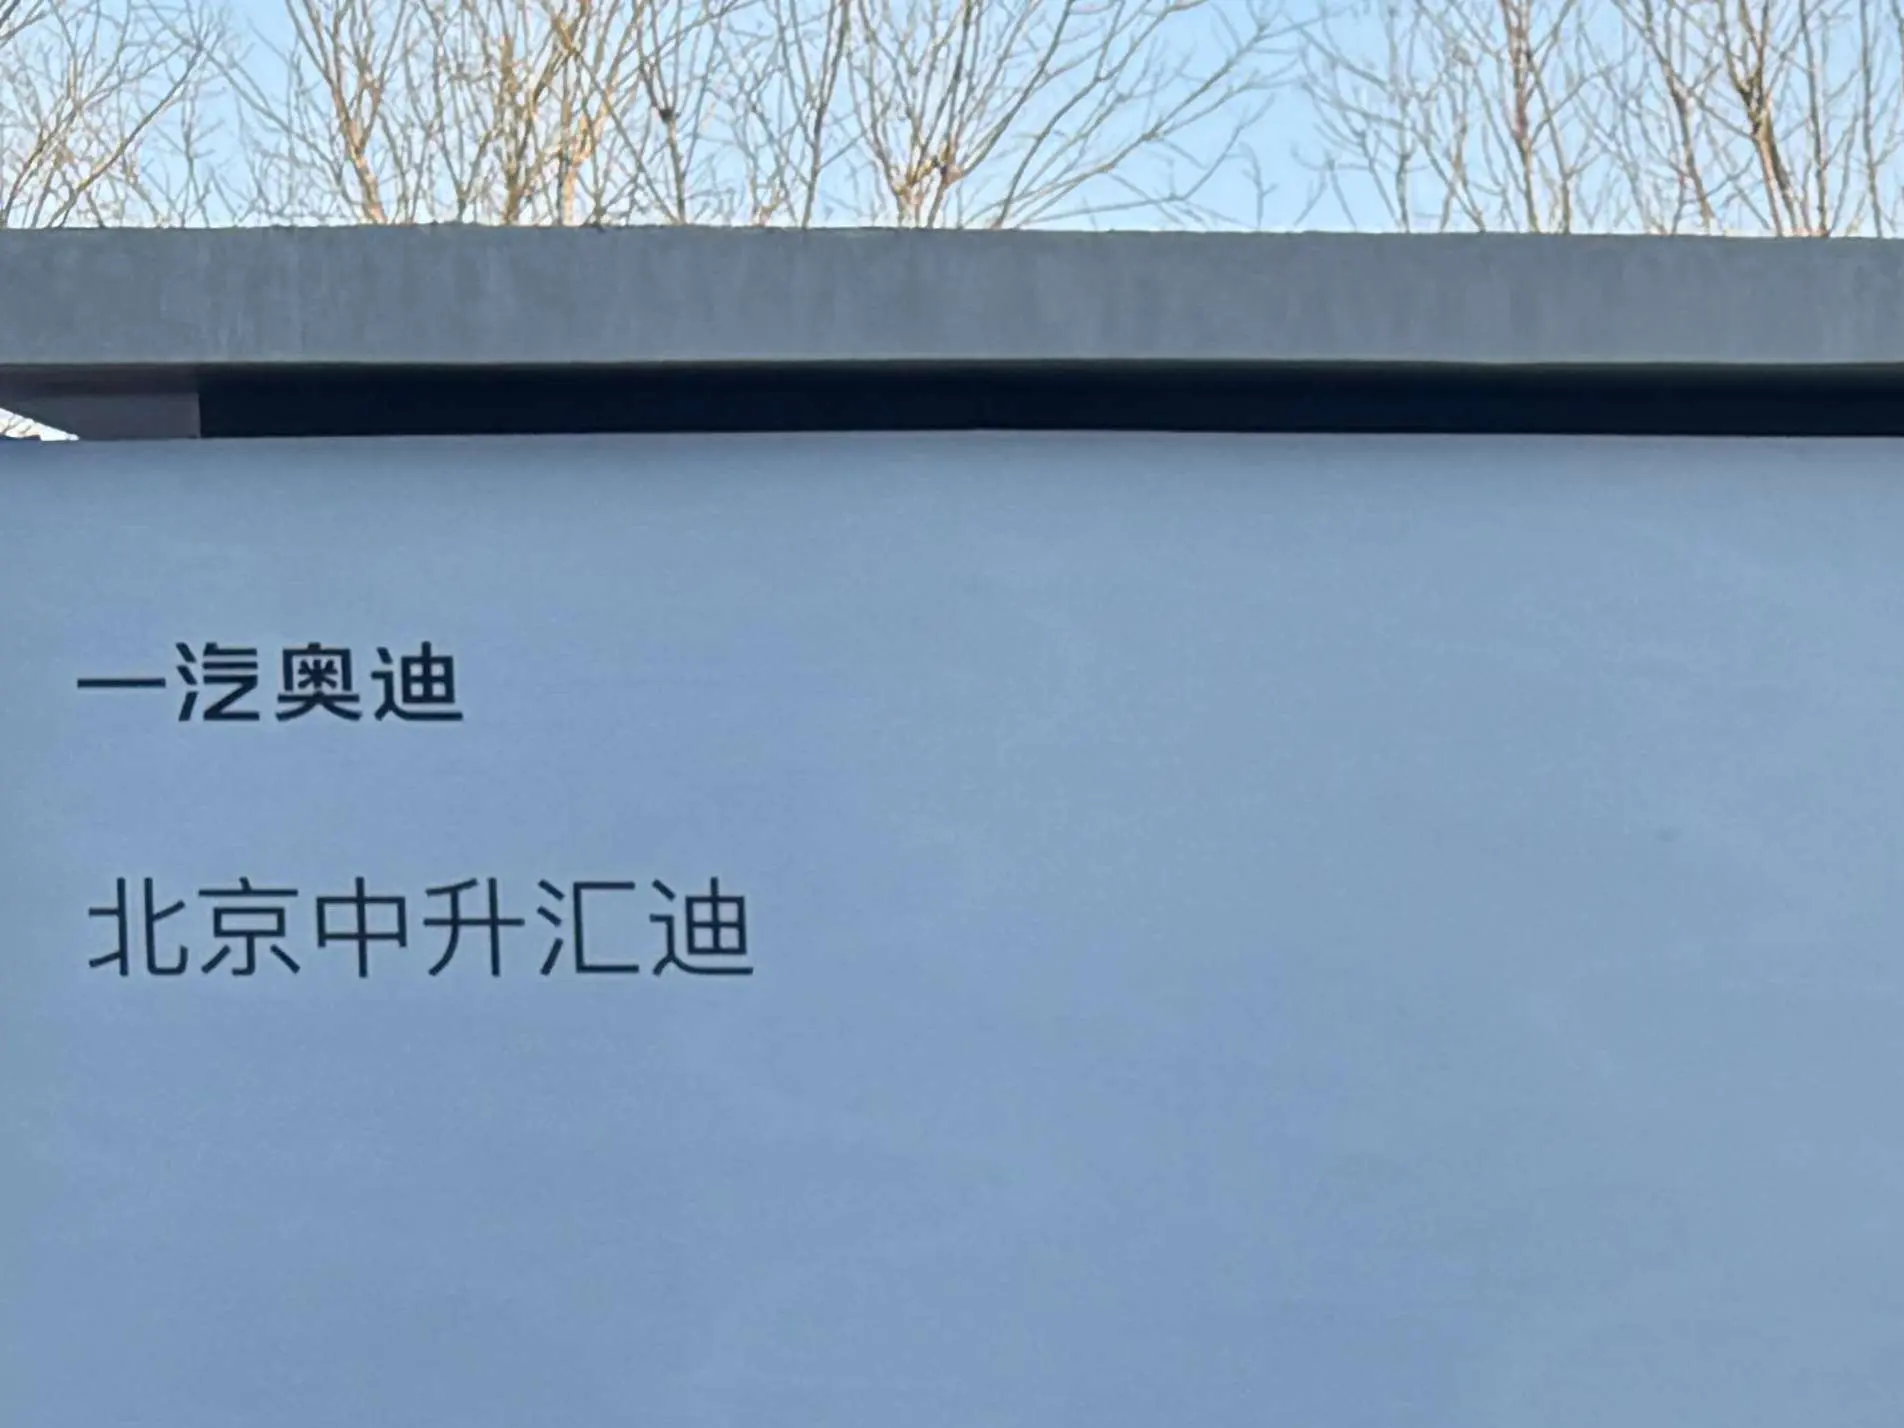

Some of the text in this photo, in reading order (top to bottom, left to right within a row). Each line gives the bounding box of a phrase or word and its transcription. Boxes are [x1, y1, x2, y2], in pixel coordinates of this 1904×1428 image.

[76, 640, 464, 722] 一汽奥迪
[87, 876, 754, 979] 北京中升汇迪
